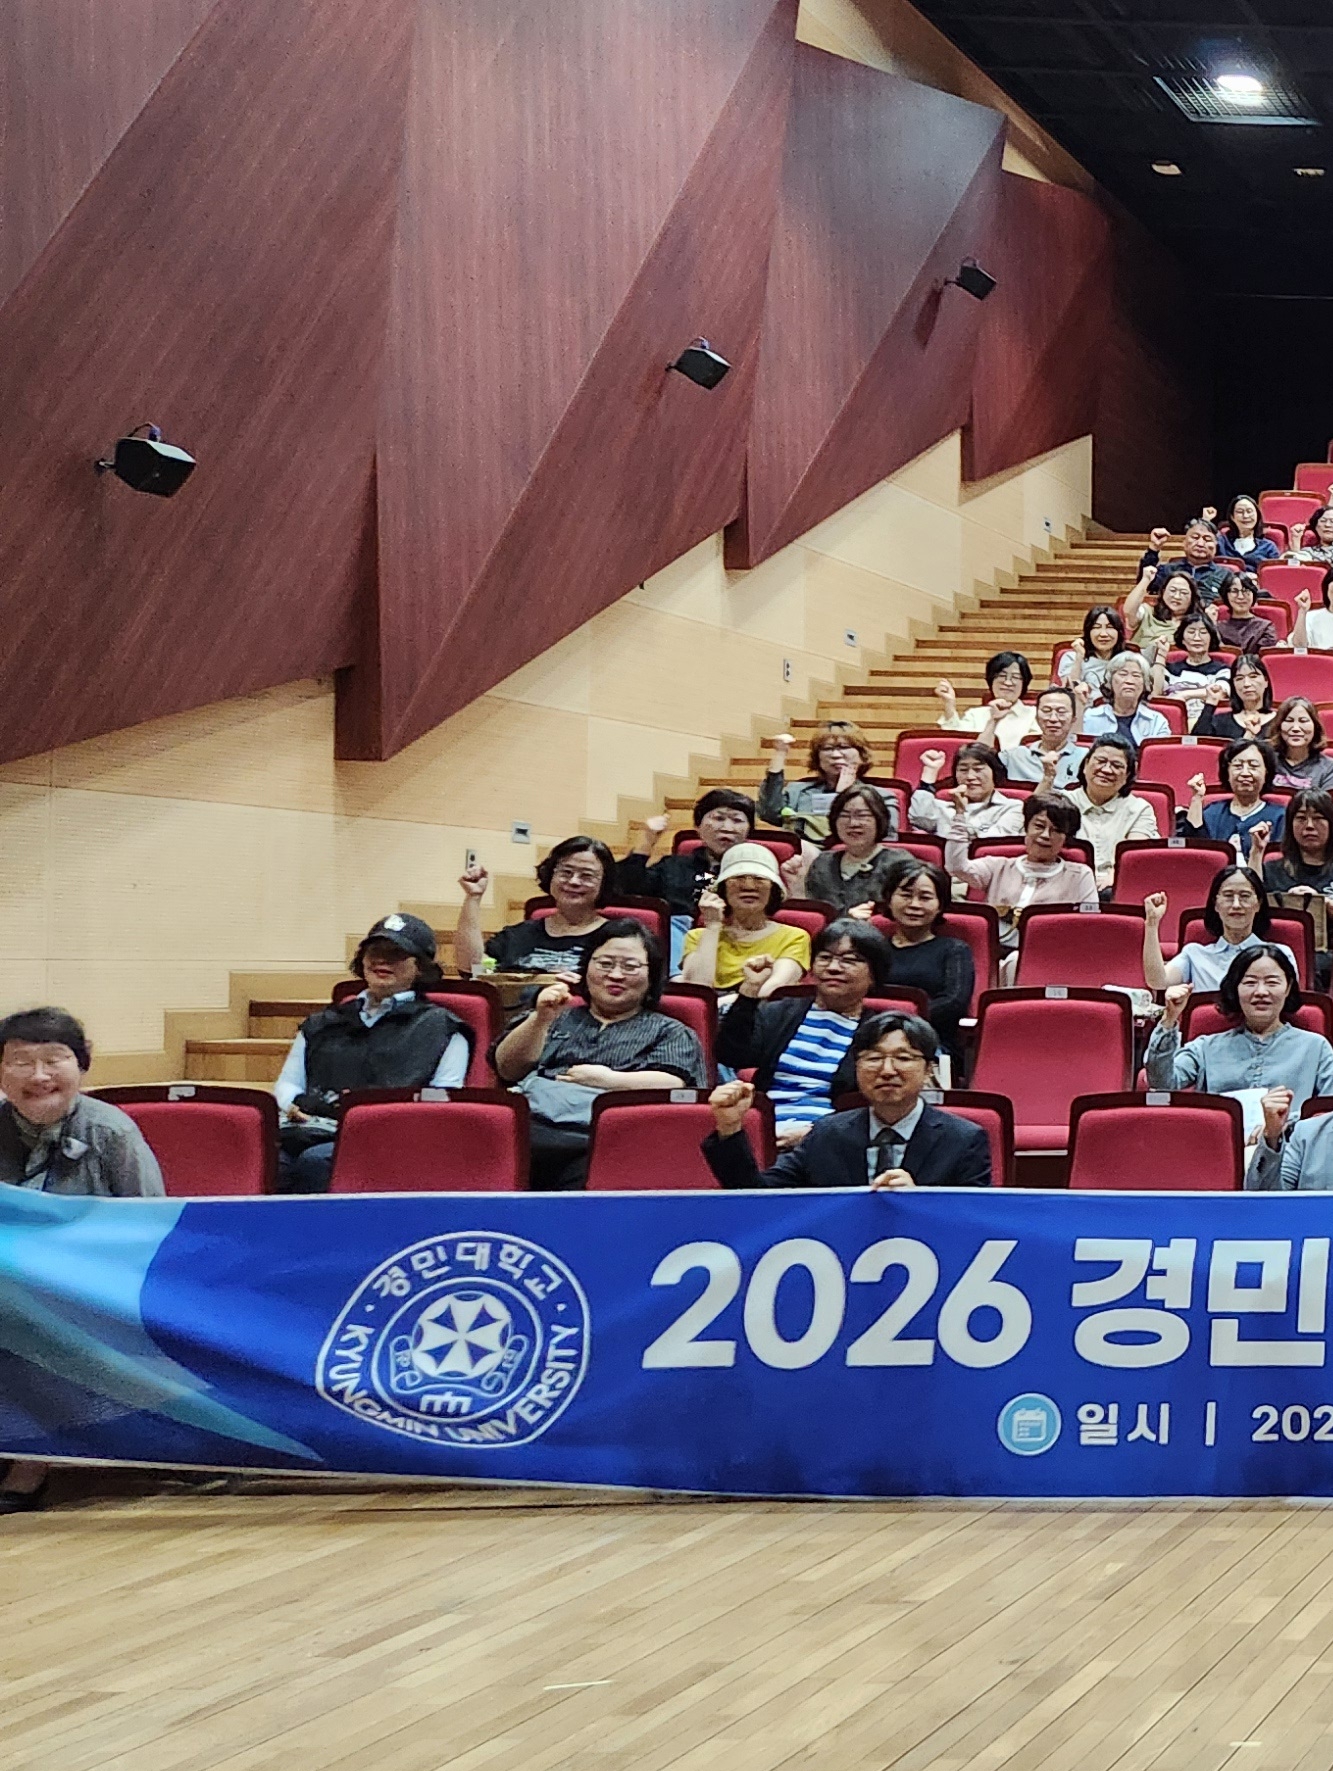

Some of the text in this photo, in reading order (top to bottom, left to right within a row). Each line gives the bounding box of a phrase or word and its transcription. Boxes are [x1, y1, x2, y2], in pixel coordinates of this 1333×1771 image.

[372, 1241, 564, 1301] 경민대학교
[642, 1237, 1032, 1369] 2026
[328, 1323, 579, 1442] KYUNGMIN UNIVERSITY
[1076, 1402, 1170, 1446] 일시
